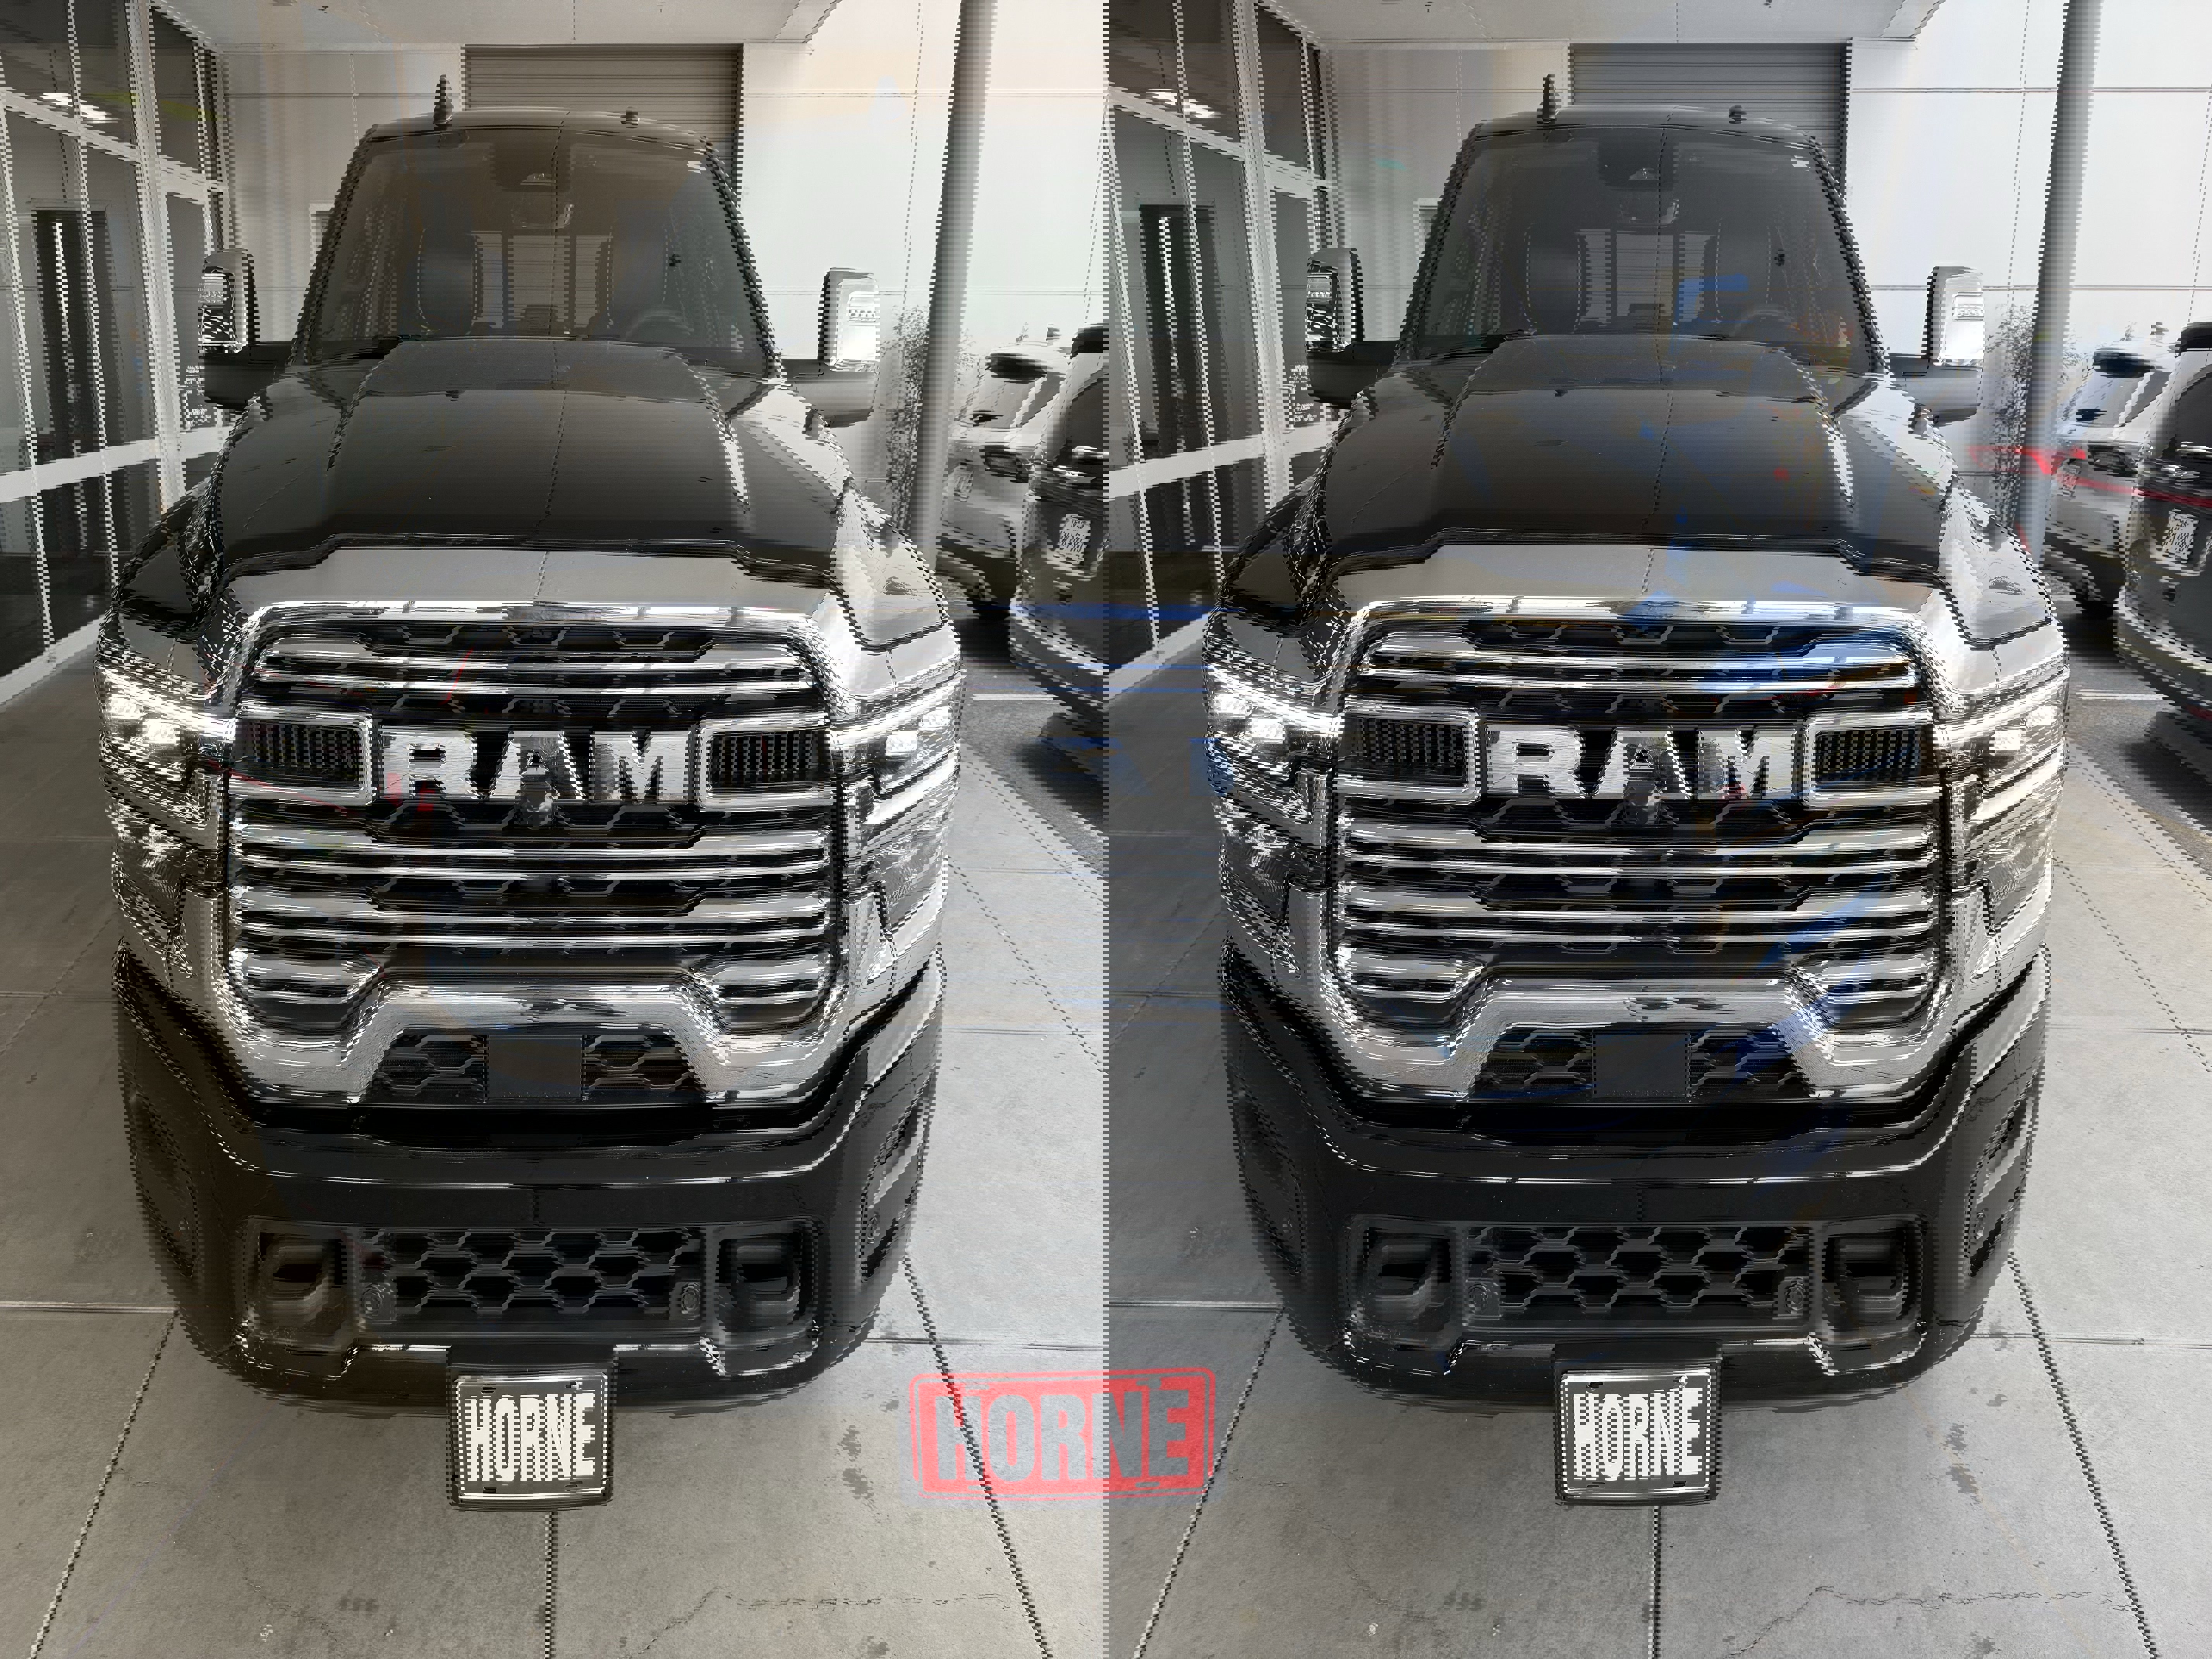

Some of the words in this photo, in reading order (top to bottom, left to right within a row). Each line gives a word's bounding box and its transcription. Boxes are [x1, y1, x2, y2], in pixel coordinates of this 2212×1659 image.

[382, 725, 693, 802] RAM
[1486, 725, 1797, 800] RAM
[464, 1391, 595, 1482] HORNE
[935, 1389, 1189, 1482] HORNE
[1573, 1388, 1703, 1481] HORNE
